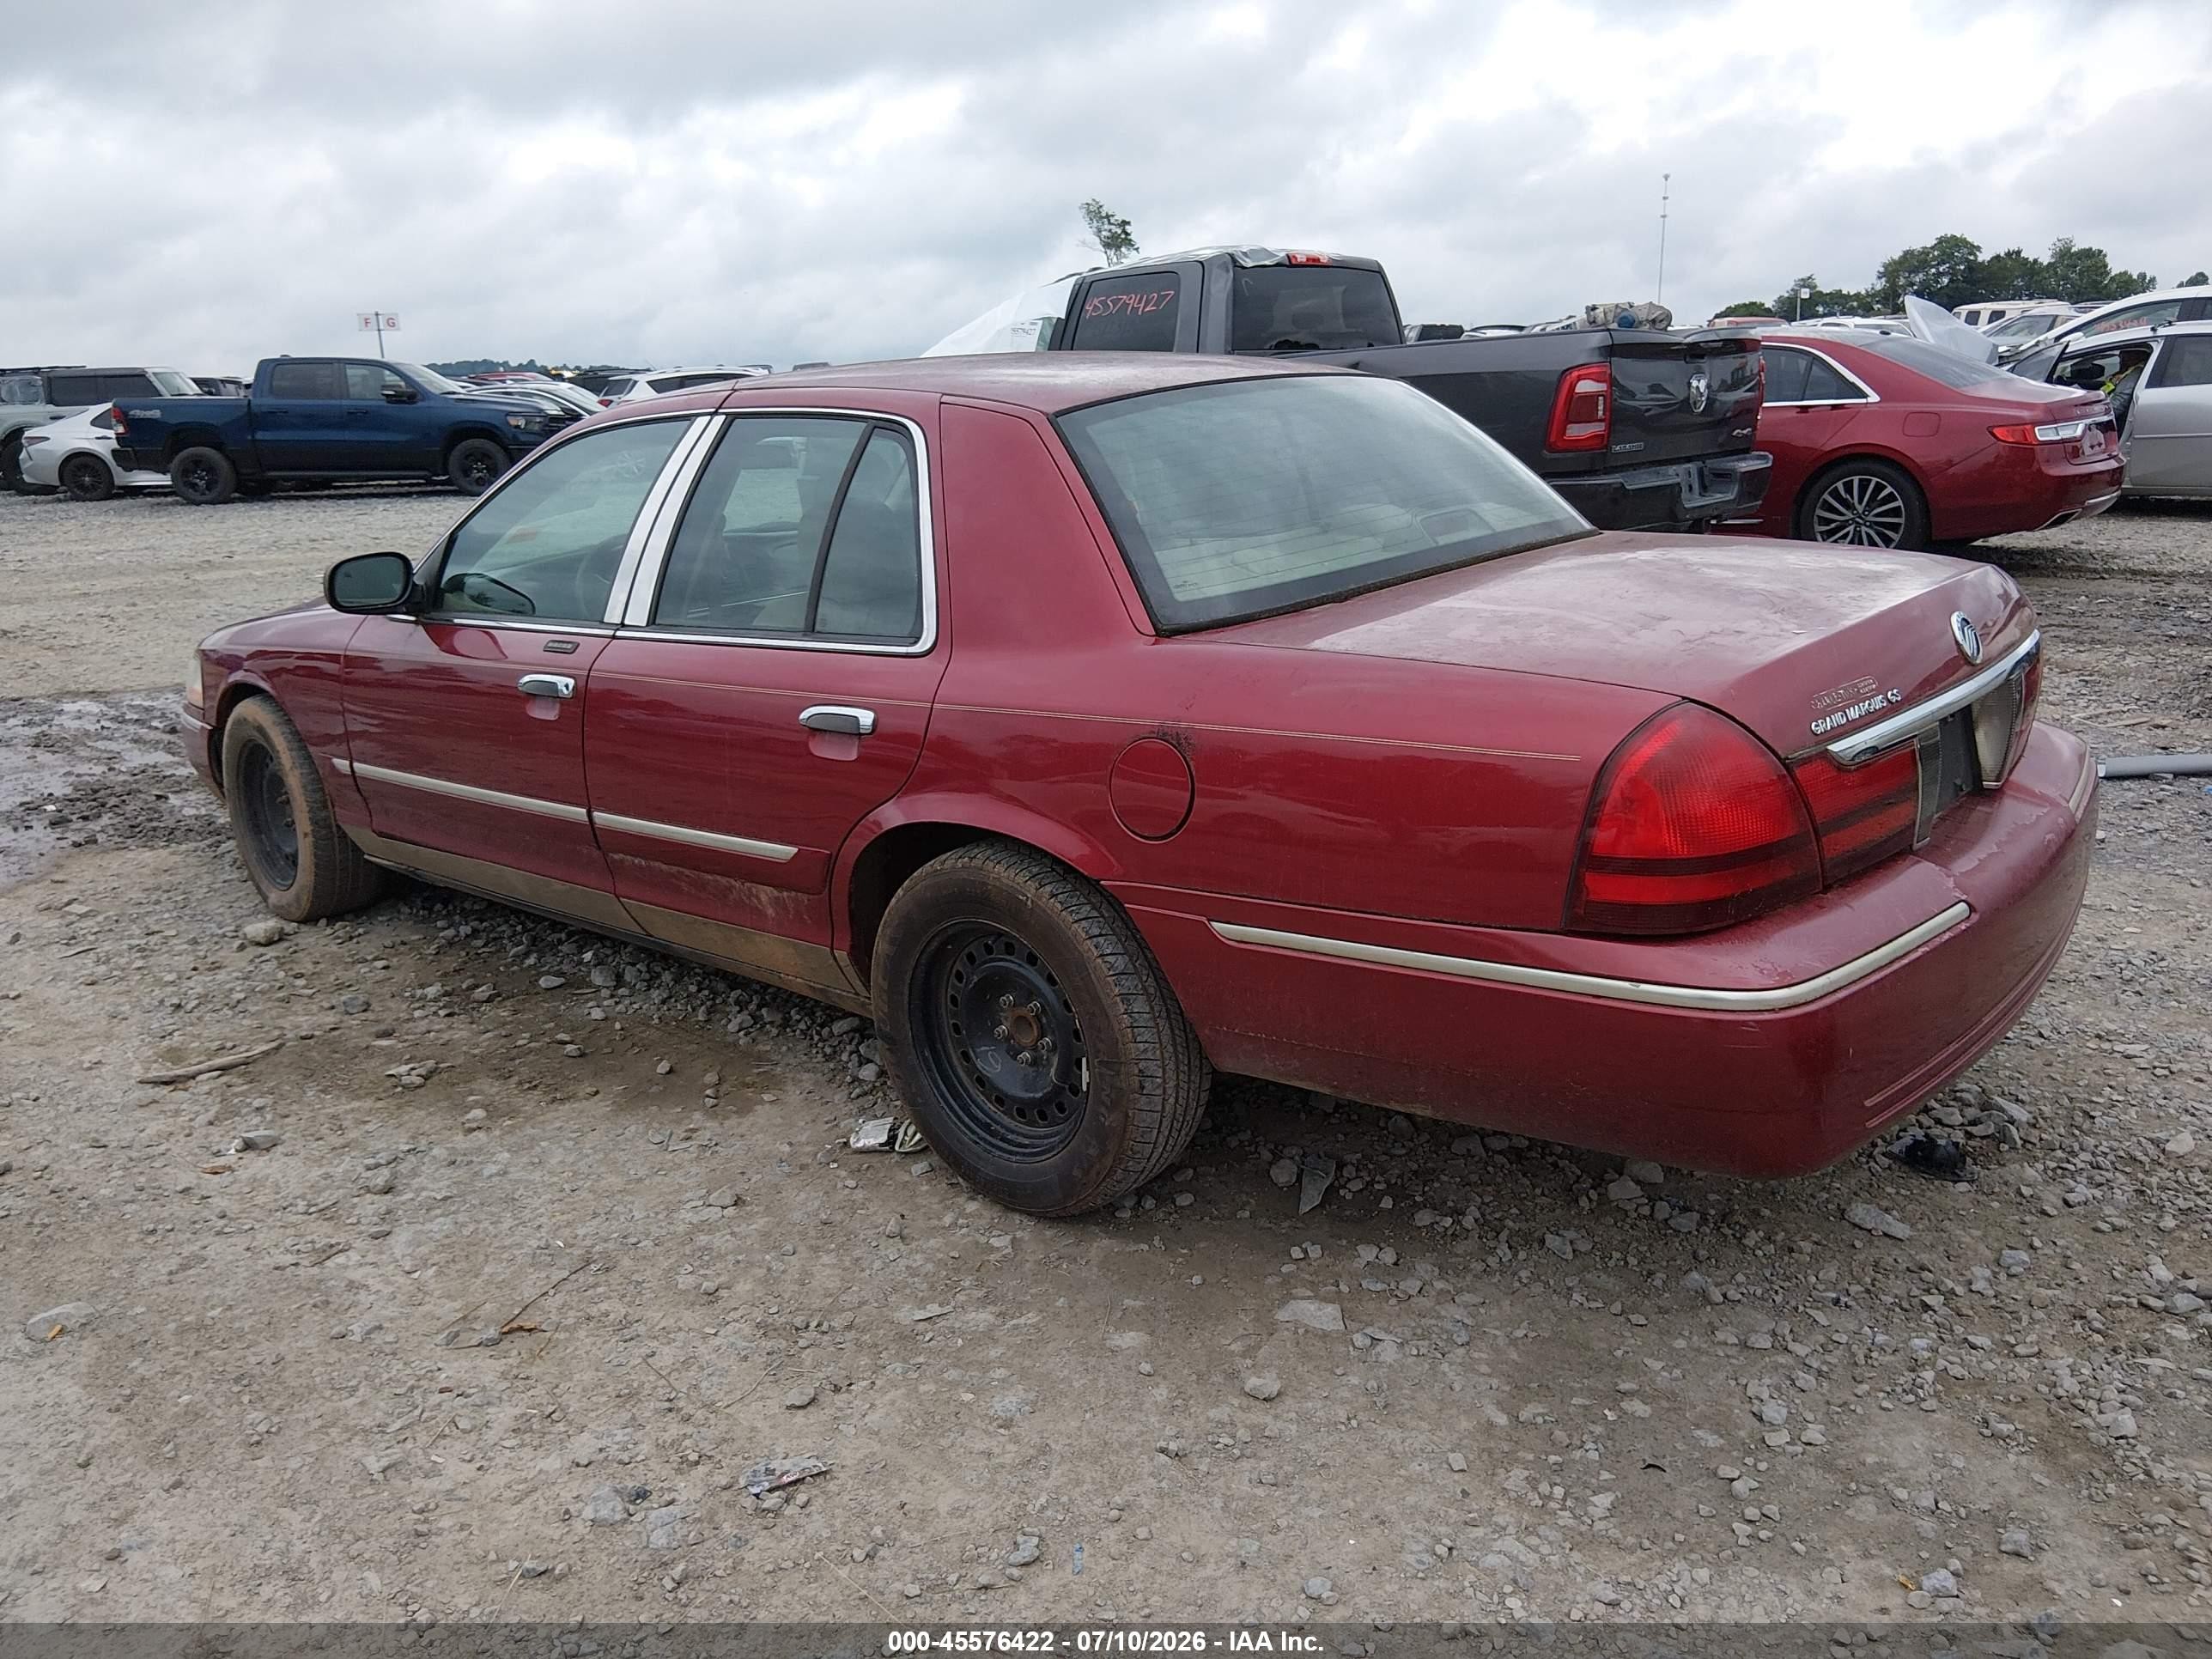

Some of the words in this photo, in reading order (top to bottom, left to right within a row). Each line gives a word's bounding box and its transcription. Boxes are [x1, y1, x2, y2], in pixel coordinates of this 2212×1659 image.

[1085, 291, 1175, 319] 45579427
[364, 318, 371, 328] F
[386, 317, 396, 328] G
[1810, 712, 1847, 735] GRAND
[1844, 695, 1887, 721] MARQUIS
[1887, 688, 1902, 703] GS
